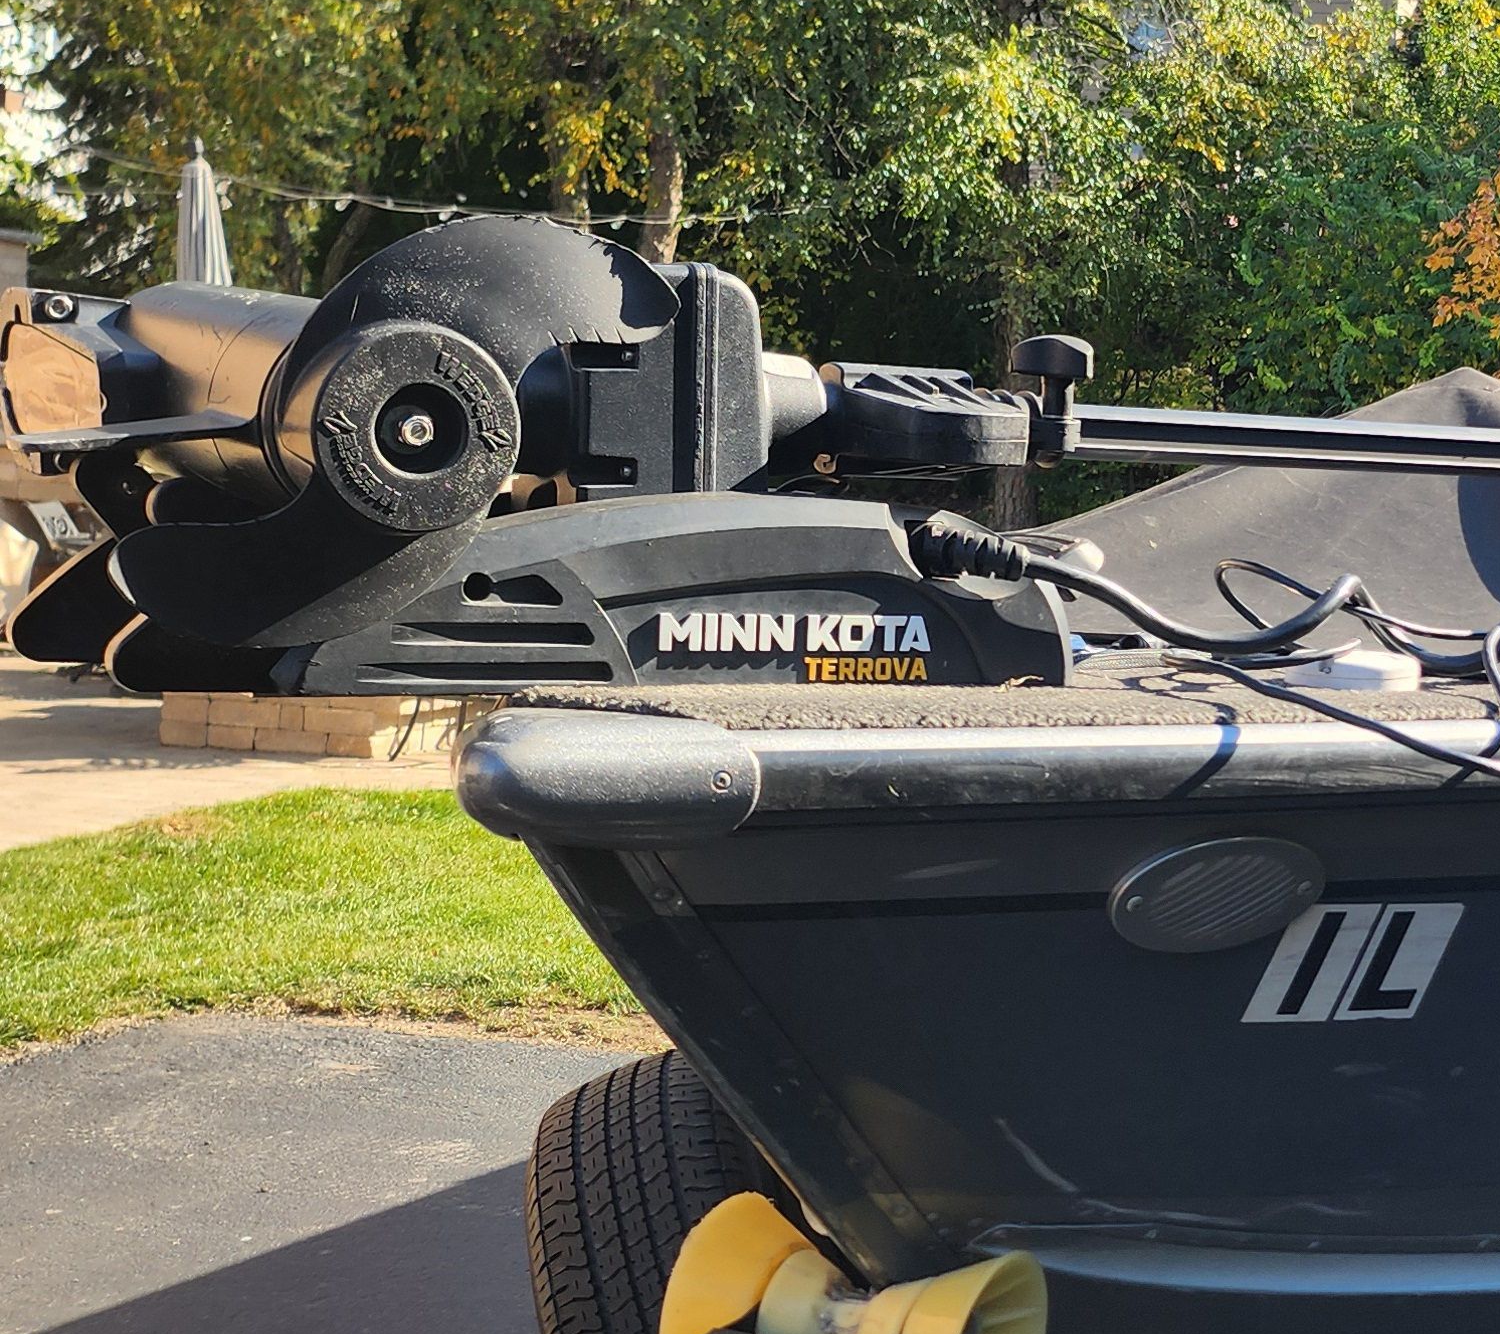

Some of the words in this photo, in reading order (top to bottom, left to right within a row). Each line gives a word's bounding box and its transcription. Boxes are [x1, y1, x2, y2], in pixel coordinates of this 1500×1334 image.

[659, 612, 795, 652] MINN
[805, 614, 932, 652] KOTA
[804, 656, 928, 681] TERROVA
[1276, 911, 1417, 1015] IL
